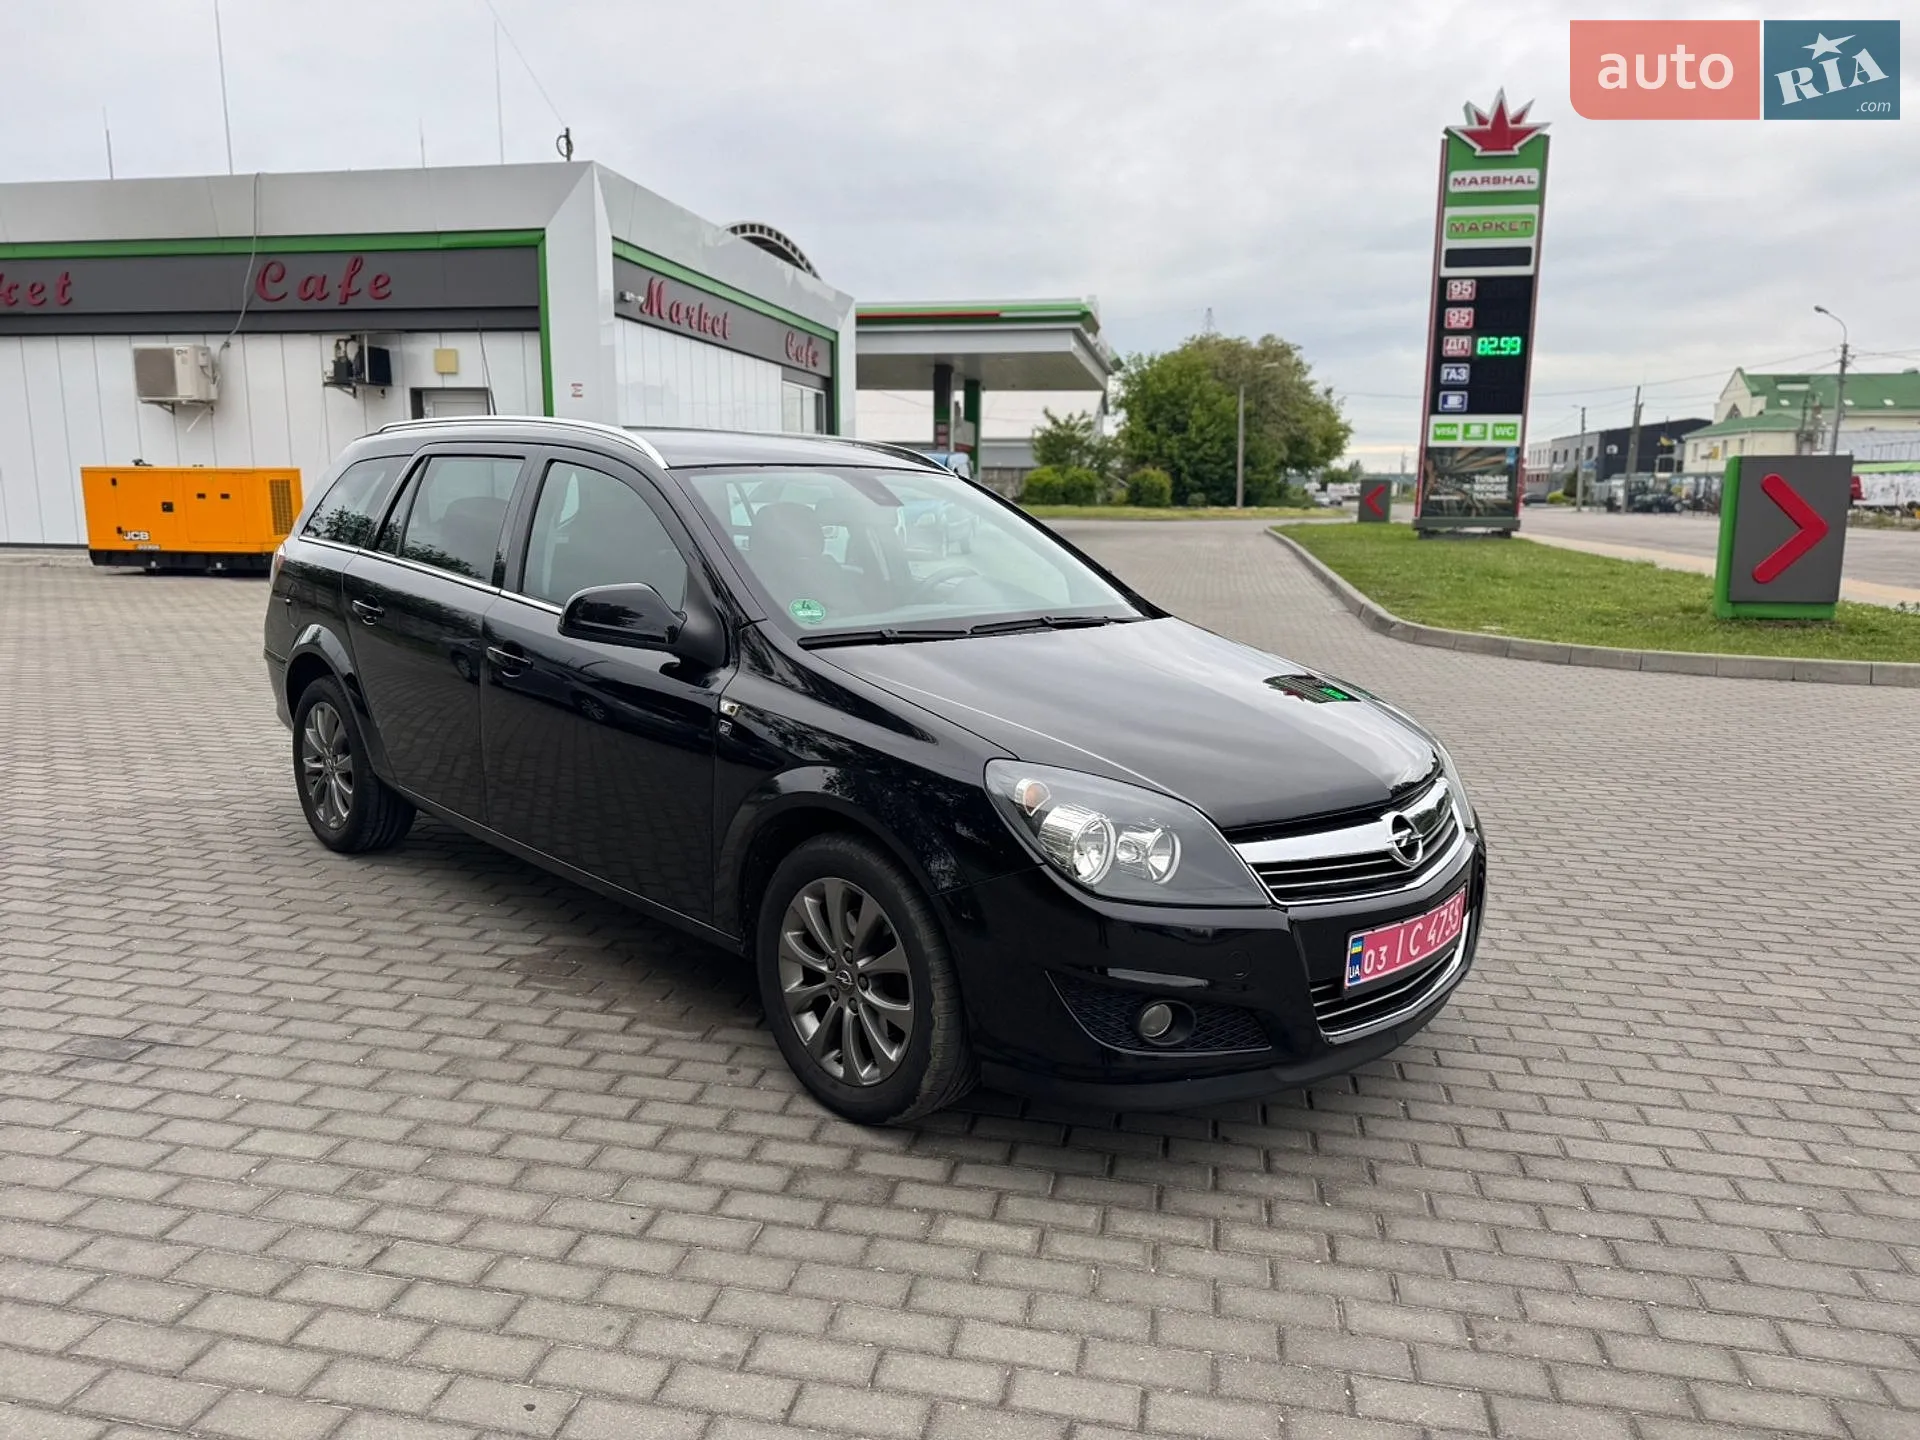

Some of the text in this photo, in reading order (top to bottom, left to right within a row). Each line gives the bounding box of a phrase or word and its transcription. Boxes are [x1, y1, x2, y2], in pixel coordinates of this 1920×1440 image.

[1452, 175, 1537, 187] MARSHAL
[255, 255, 392, 306] Cafe
[1451, 282, 1472, 295] 95
[639, 276, 820, 368] Market Cafe
[1449, 310, 1469, 323] 95
[1443, 368, 1466, 381] ГАЗ
[1495, 426, 1515, 437] WC
[123, 530, 150, 541] JCB
[1364, 945, 1387, 974] 03
[1396, 922, 1423, 963] IC
[1349, 965, 1360, 978] UA
